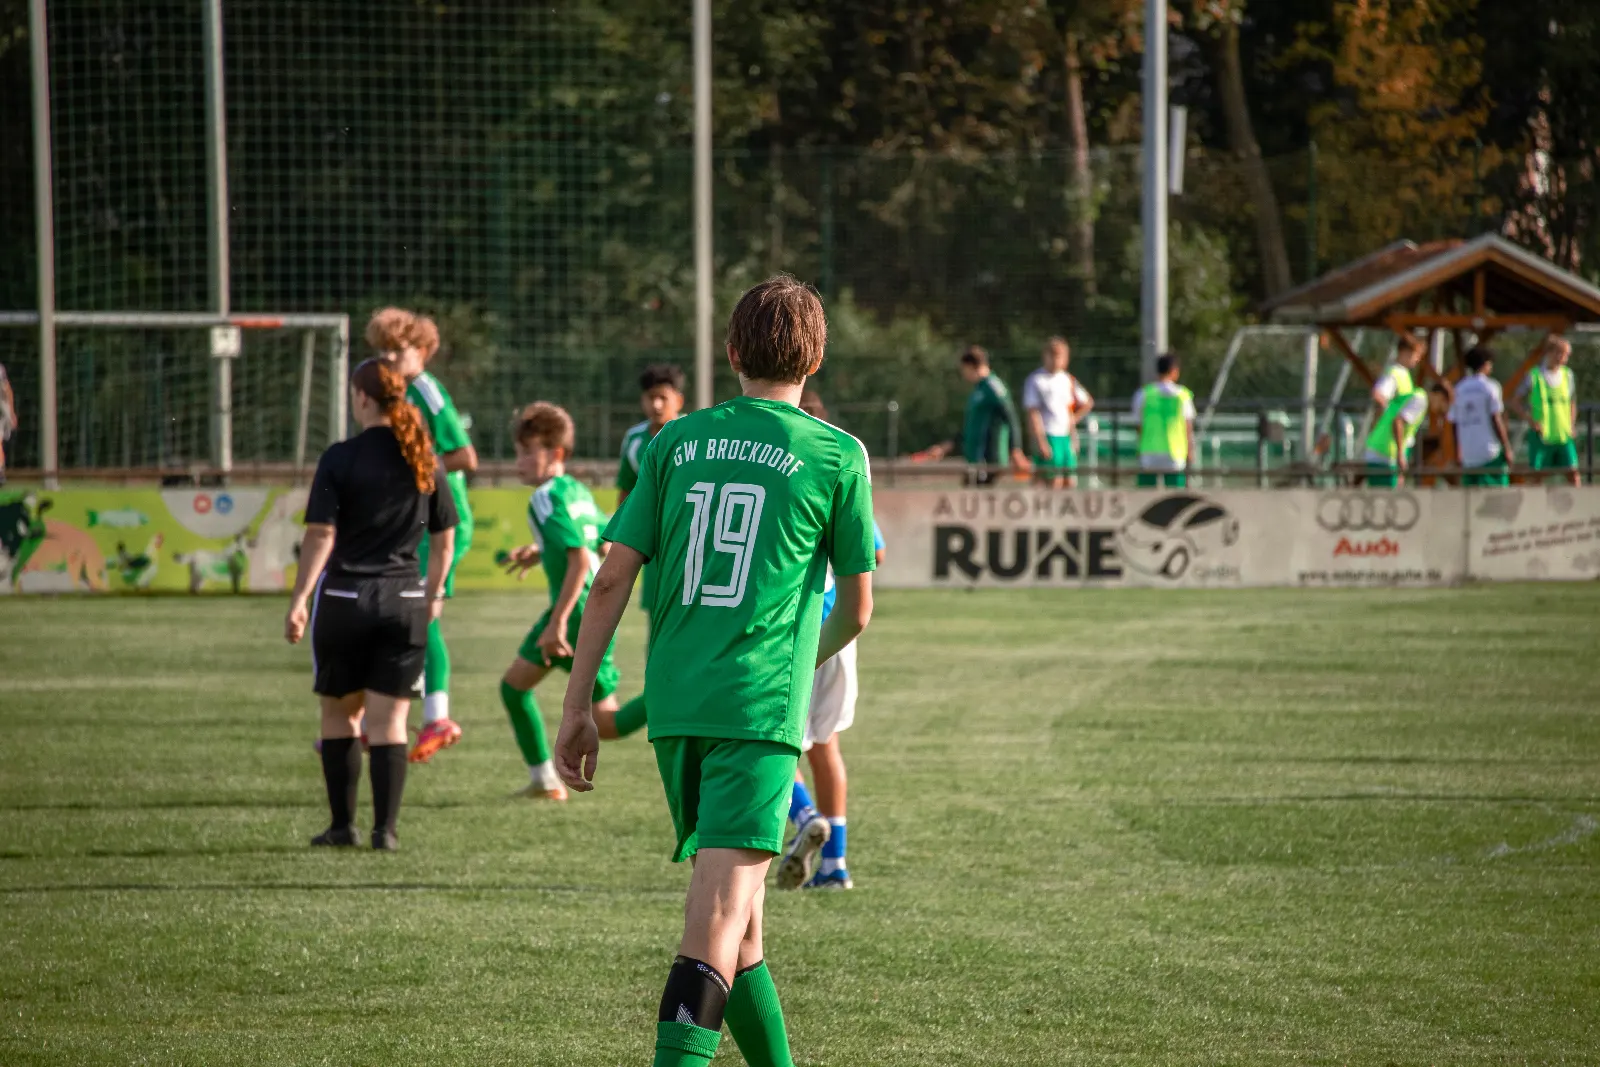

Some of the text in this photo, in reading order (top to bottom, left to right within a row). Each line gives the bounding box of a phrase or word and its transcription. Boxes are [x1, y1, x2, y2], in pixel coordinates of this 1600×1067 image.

[674, 438, 804, 477] GW BROCKDORF
[931, 492, 1126, 519] AUTOHAUS
[682, 481, 766, 608] 19
[933, 525, 1123, 580] RUHE
[1333, 536, 1399, 557] Audi
